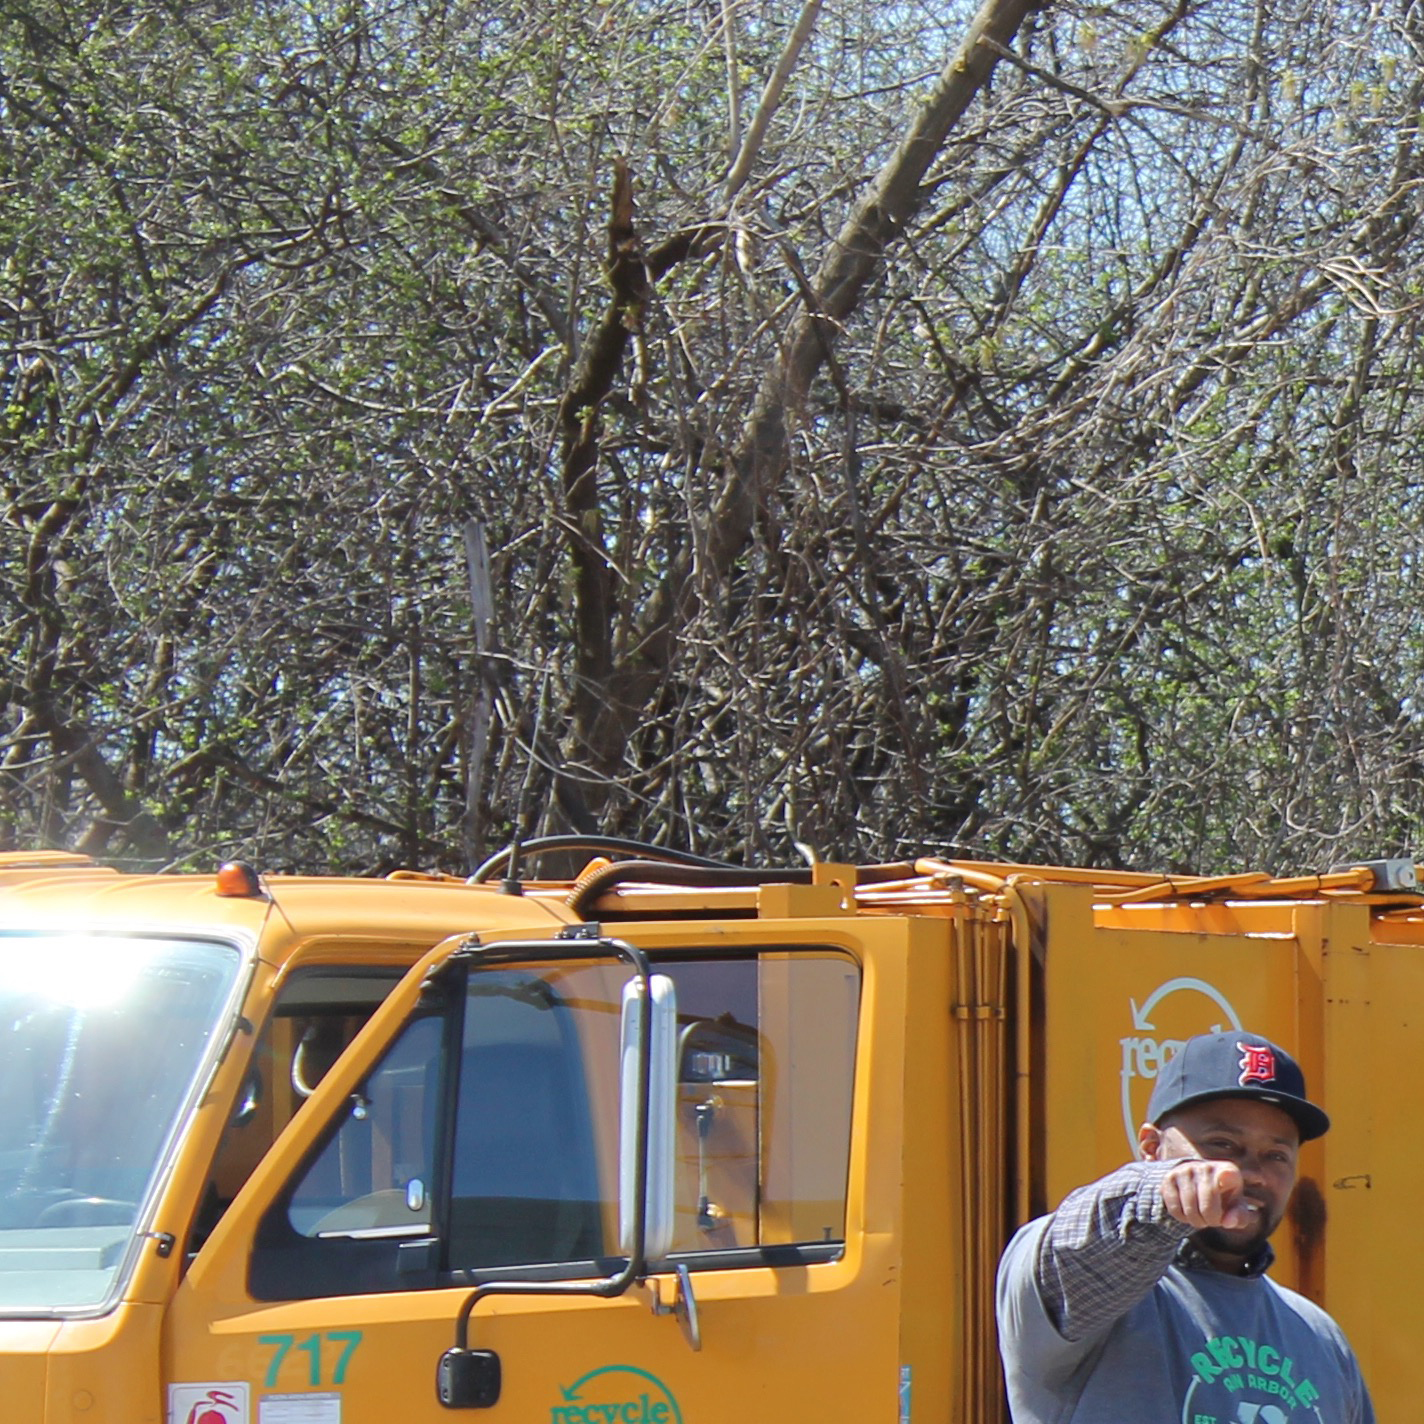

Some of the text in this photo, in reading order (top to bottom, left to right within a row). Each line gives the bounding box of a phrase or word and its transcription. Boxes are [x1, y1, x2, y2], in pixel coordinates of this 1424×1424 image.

[258, 1330, 363, 1388] 717
[1190, 1335, 1320, 1409] RECYCLE
[1247, 1373, 1298, 1411] ARBOR
